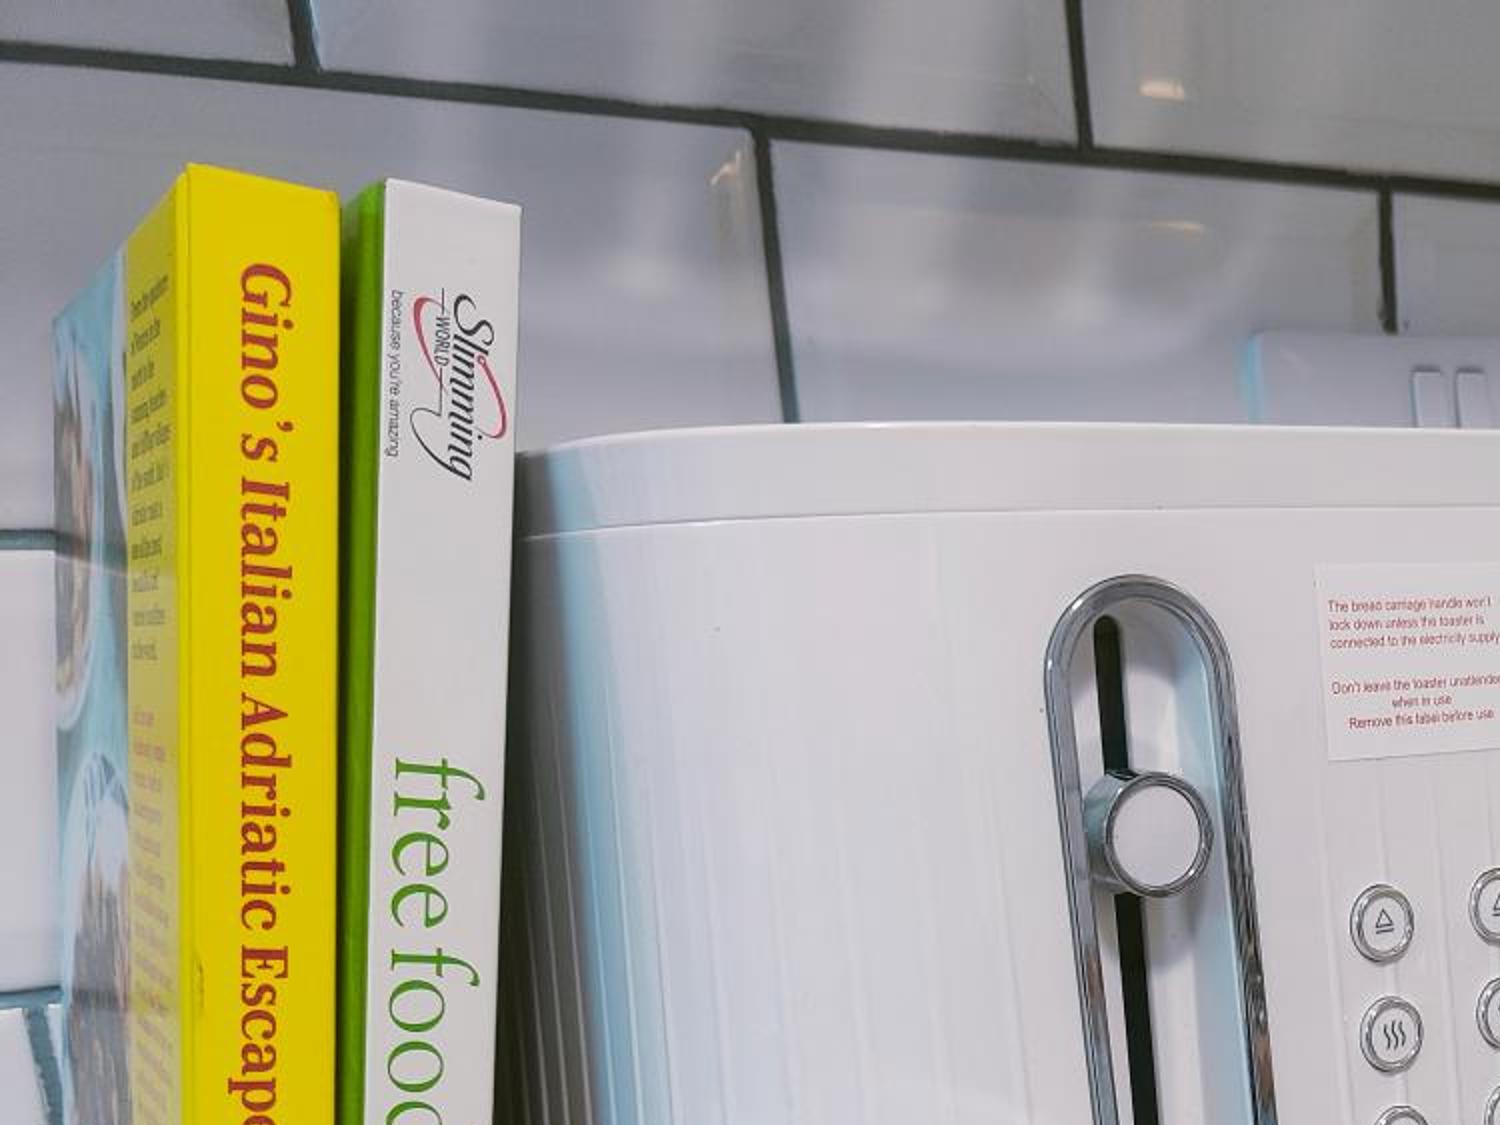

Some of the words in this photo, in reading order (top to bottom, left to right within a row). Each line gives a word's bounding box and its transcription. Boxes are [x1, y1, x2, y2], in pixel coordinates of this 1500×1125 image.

[391, 289, 403, 350] because
[435, 315, 450, 367] WORLD
[241, 263, 294, 462] Gino's
[385, 353, 401, 396] you're
[410, 294, 494, 481] Slimming
[385, 399, 401, 458] amazing
[241, 476, 293, 679] Italian
[1329, 599, 1349, 613] The
[1352, 599, 1383, 612] bread
[1385, 598, 1426, 611] carriage
[1429, 597, 1463, 609] handle
[1329, 619, 1350, 631] lock
[1353, 618, 1383, 630] down
[1385, 617, 1418, 629] unless
[1421, 616, 1437, 627] the
[1440, 615, 1473, 627] toaster
[1475, 614, 1485, 625] is
[1329, 635, 1384, 649] connected
[1387, 636, 1398, 647] to
[1401, 634, 1416, 646] the
[1419, 632, 1466, 646] electricity
[1469, 632, 1500, 645] supply
[1331, 681, 1362, 695] Don't
[1364, 680, 1391, 692] leave
[1393, 679, 1410, 691] the
[1413, 677, 1448, 689] toaster
[1391, 696, 1418, 708] when
[1421, 696, 1431, 706] in
[1433, 696, 1452, 706] use
[1349, 716, 1393, 730] Remove
[1395, 714, 1413, 726] this
[1416, 712, 1440, 725] label
[1442, 710, 1473, 722] before
[1475, 709, 1494, 720] use
[241, 691, 292, 931] Adriatic
[387, 758, 486, 930] free
